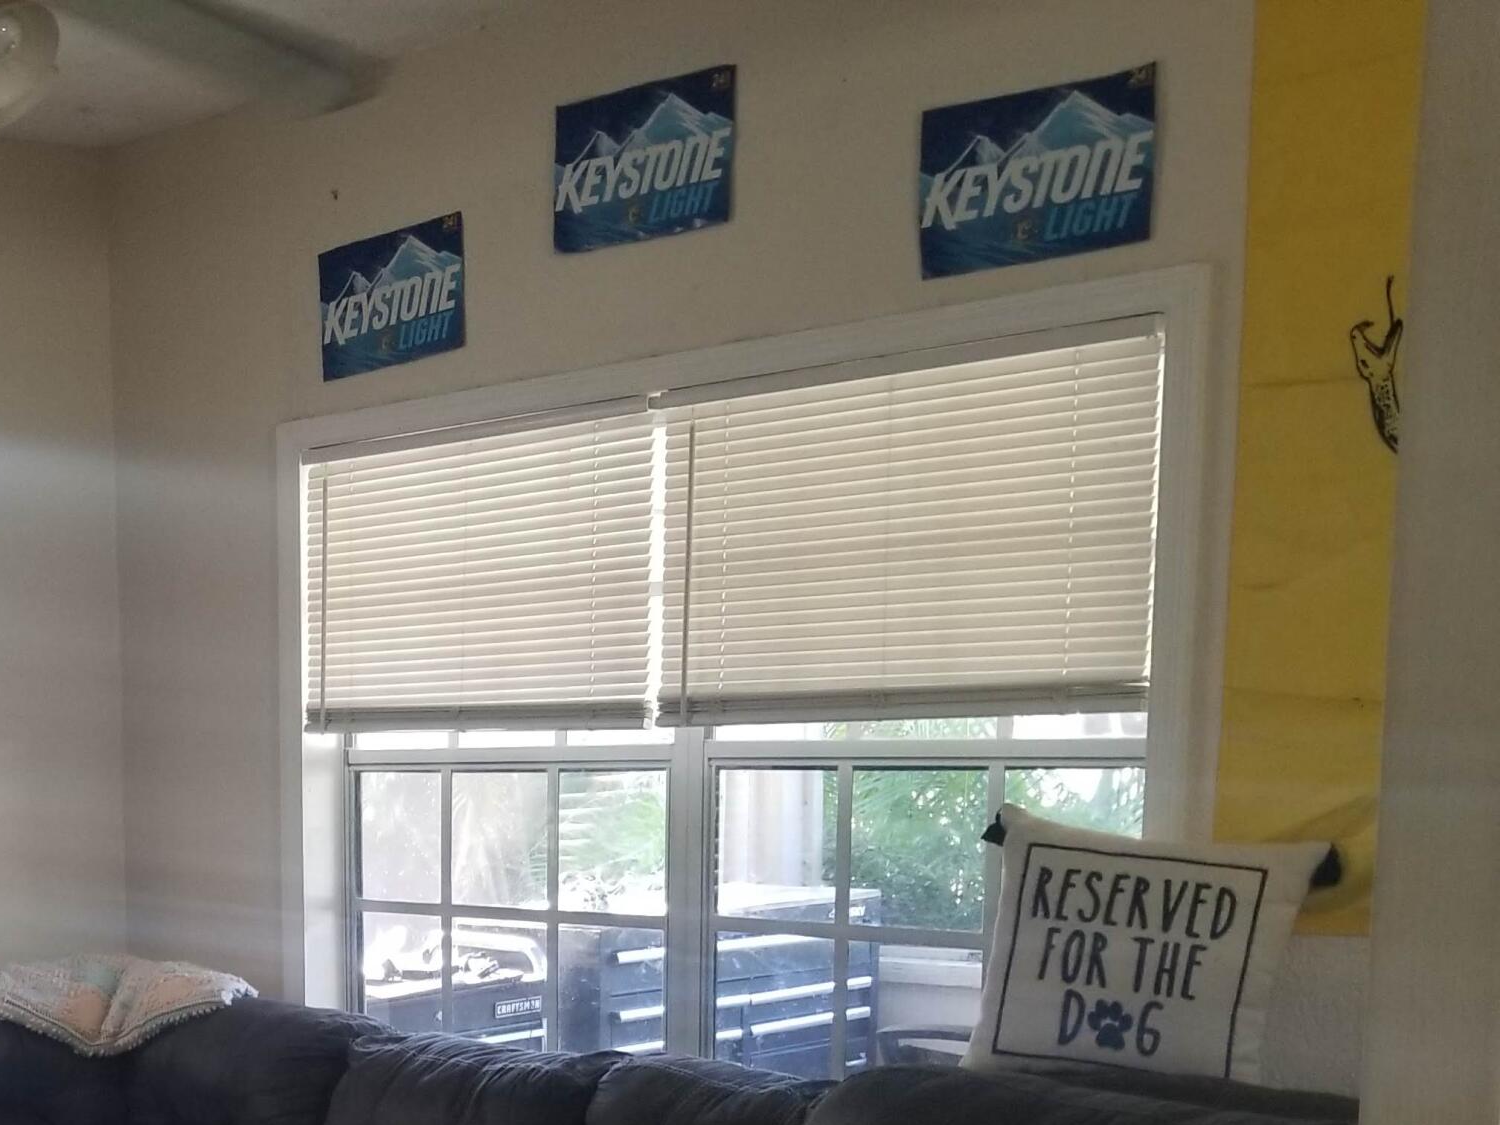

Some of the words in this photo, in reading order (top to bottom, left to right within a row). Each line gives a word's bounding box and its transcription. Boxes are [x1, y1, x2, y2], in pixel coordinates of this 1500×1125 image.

[555, 127, 731, 214] KEYSTONE
[650, 181, 720, 223] LIGHT
[921, 130, 1154, 230] KEYSTONE
[1043, 194, 1137, 241] LIGHT
[323, 264, 461, 346] KEYSTONE
[400, 310, 454, 351] LIGHT
[1030, 866, 1237, 940] RESERVED
[1037, 926, 1108, 989] FOR
[1131, 936, 1208, 1001] THE
